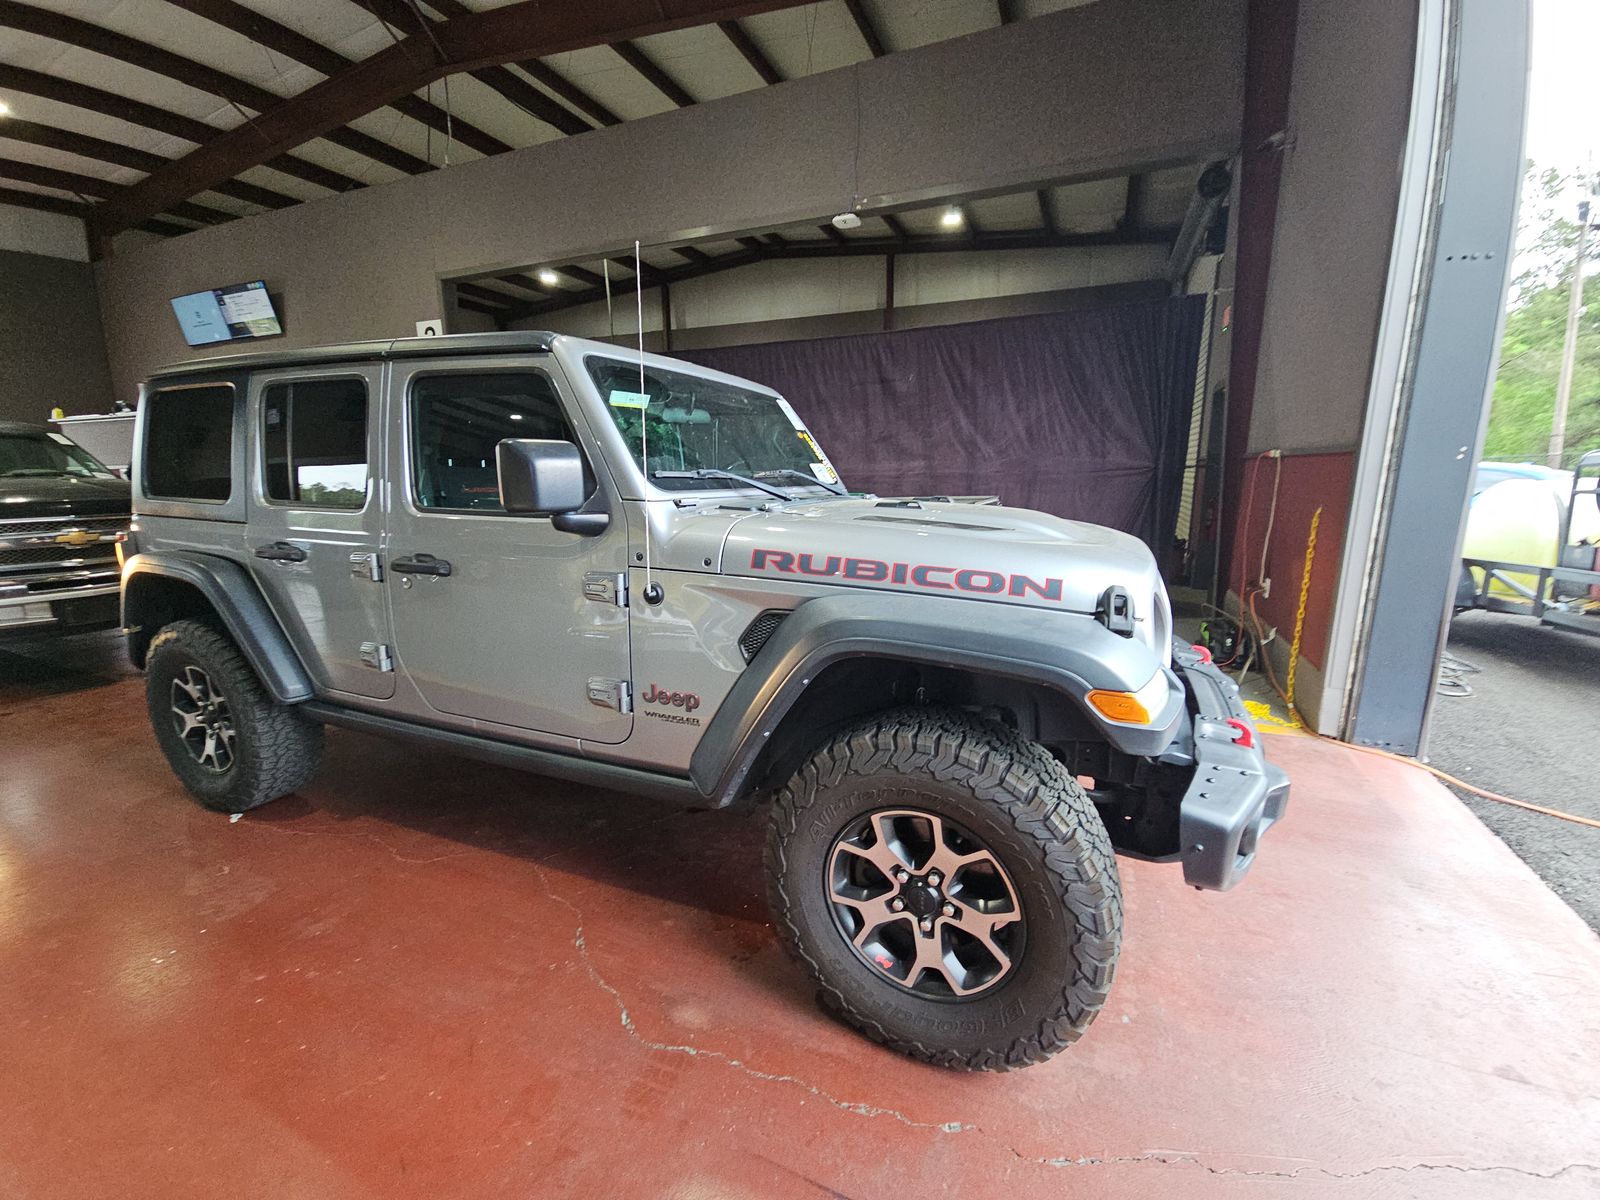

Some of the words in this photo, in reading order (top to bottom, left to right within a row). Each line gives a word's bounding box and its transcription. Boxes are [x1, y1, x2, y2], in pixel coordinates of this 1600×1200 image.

[750, 548, 1063, 601] RUBICON
[642, 682, 701, 712] Jeep
[644, 710, 700, 724] WRANGLER
